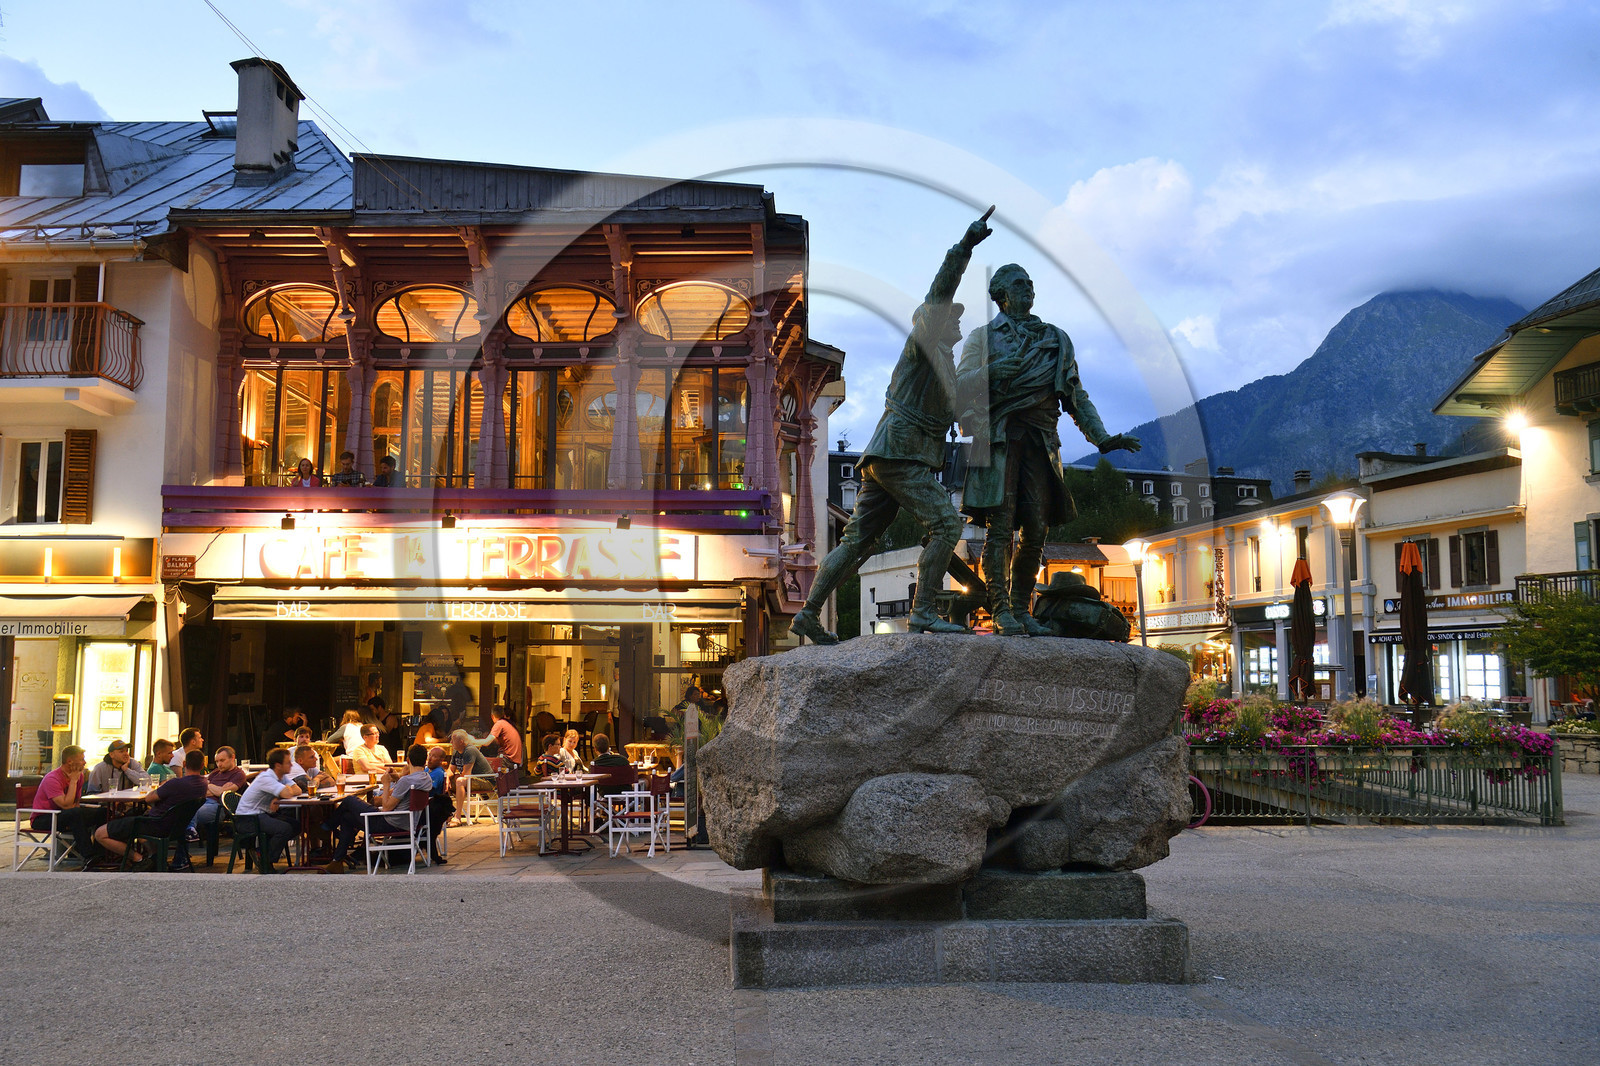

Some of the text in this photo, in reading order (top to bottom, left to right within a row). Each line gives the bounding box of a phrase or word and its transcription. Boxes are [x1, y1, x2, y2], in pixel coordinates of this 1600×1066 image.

[456, 534, 682, 580] TERRASSE
[1447, 592, 1513, 607] IMMOBILIER
[276, 601, 677, 620] BAR LA TERRASSE BAR
[18, 621, 88, 635] Immobilier
[1476, 631, 1492, 639] Estate
